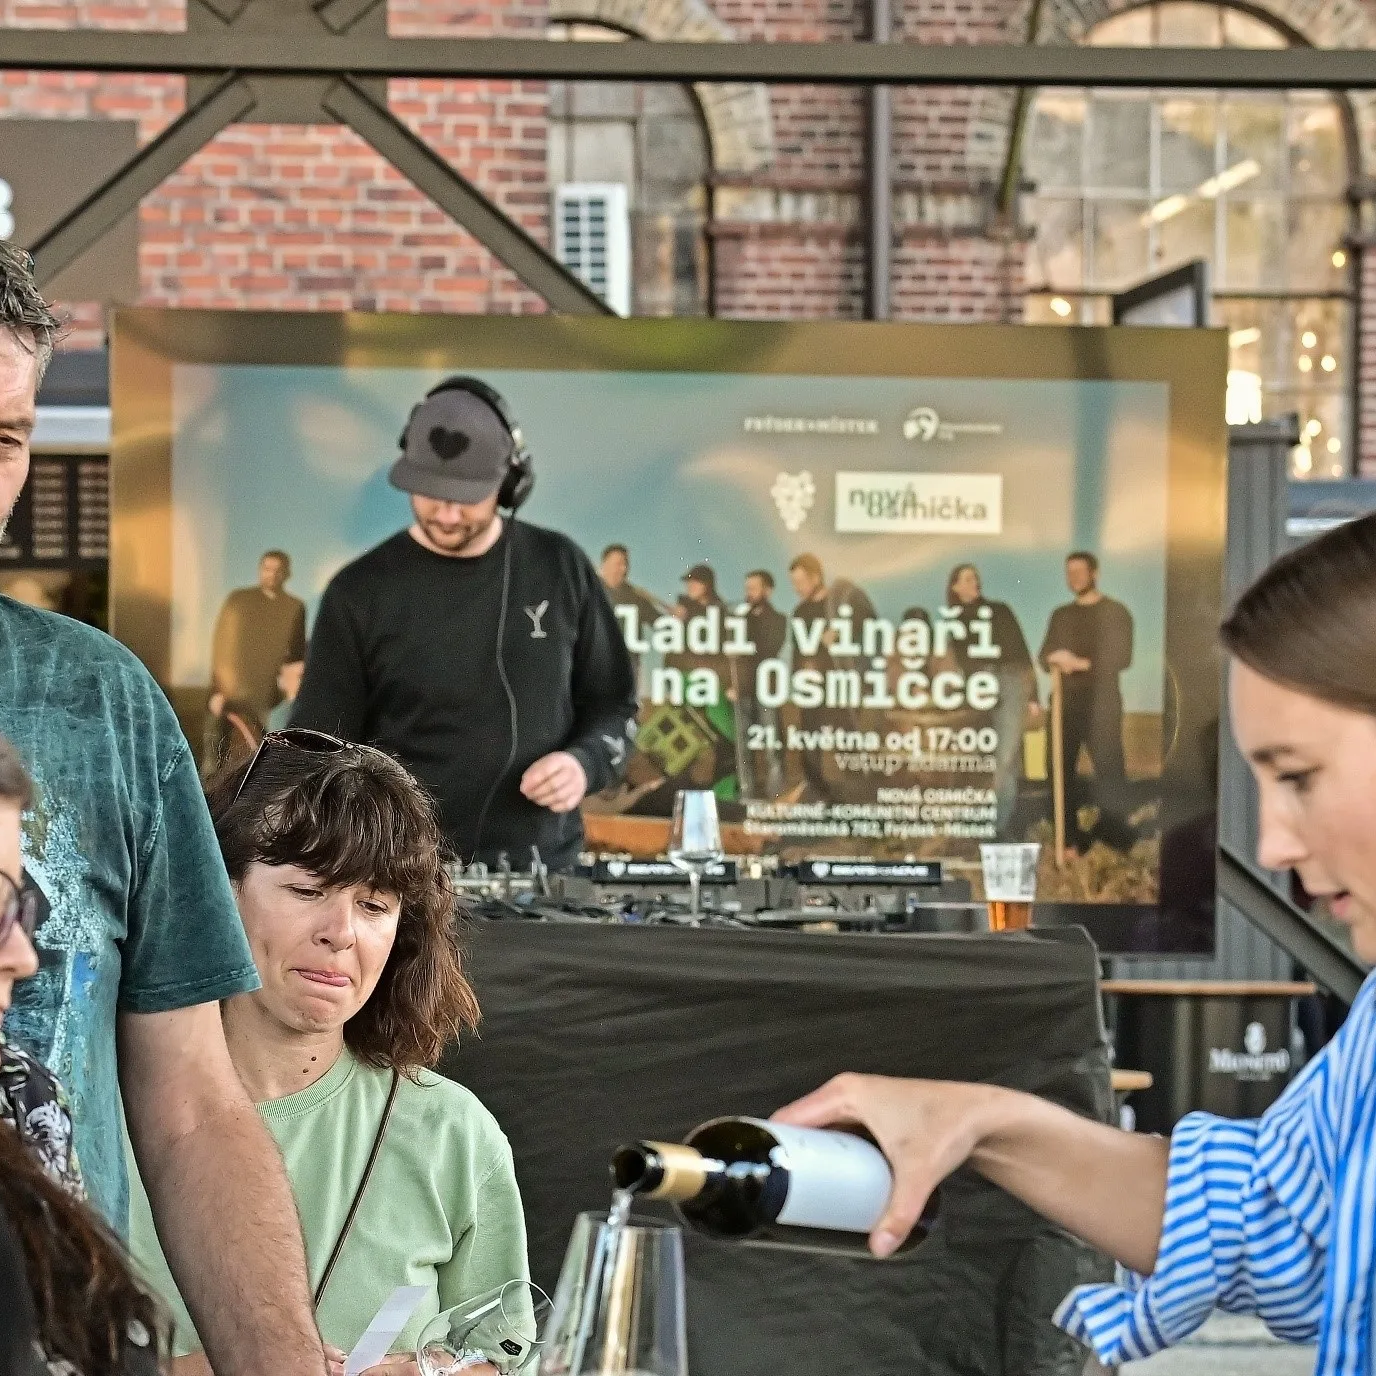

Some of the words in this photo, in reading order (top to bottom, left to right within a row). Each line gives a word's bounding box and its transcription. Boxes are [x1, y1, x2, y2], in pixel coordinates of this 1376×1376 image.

[615, 603, 756, 654] ladí
[793, 604, 1001, 658] vinaři
[651, 668, 720, 707] na
[755, 657, 1000, 710] Osmičce
[747, 724, 782, 750] 21.
[787, 724, 880, 751] května
[885, 727, 921, 751] od
[927, 727, 999, 753] 17:00
[835, 752, 904, 775] vstup
